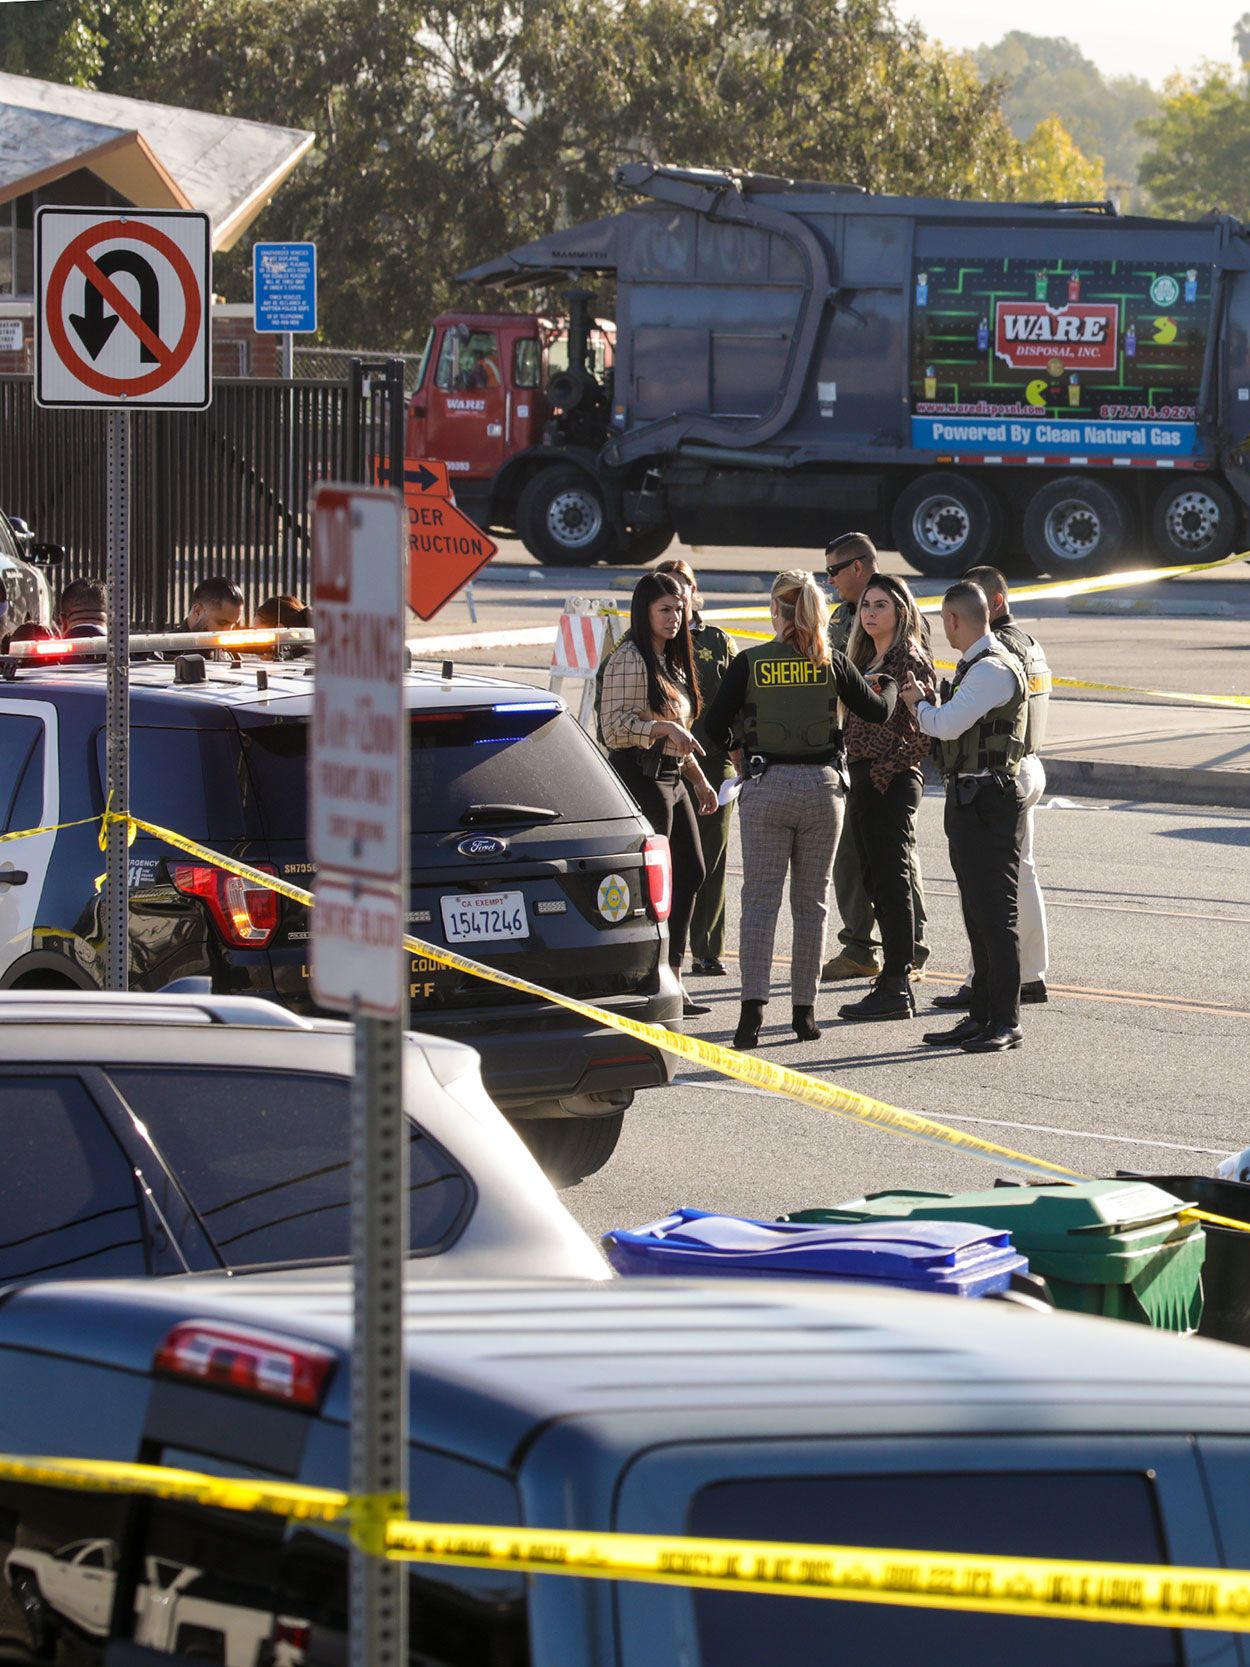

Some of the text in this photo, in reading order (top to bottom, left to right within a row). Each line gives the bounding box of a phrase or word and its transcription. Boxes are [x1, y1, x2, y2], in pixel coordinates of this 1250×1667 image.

[1004, 315, 1106, 342] WARE
[1016, 346, 1101, 358] DISPOSAL, INC.
[447, 399, 485, 410] WARE
[933, 423, 1181, 445] Powered By Clean Natural Gas
[409, 508, 443, 526] DER
[409, 534, 483, 556] RUCTION
[761, 661, 822, 684] SHERIFF
[470, 841, 496, 852] Ford
[451, 908, 522, 935] 1547246
